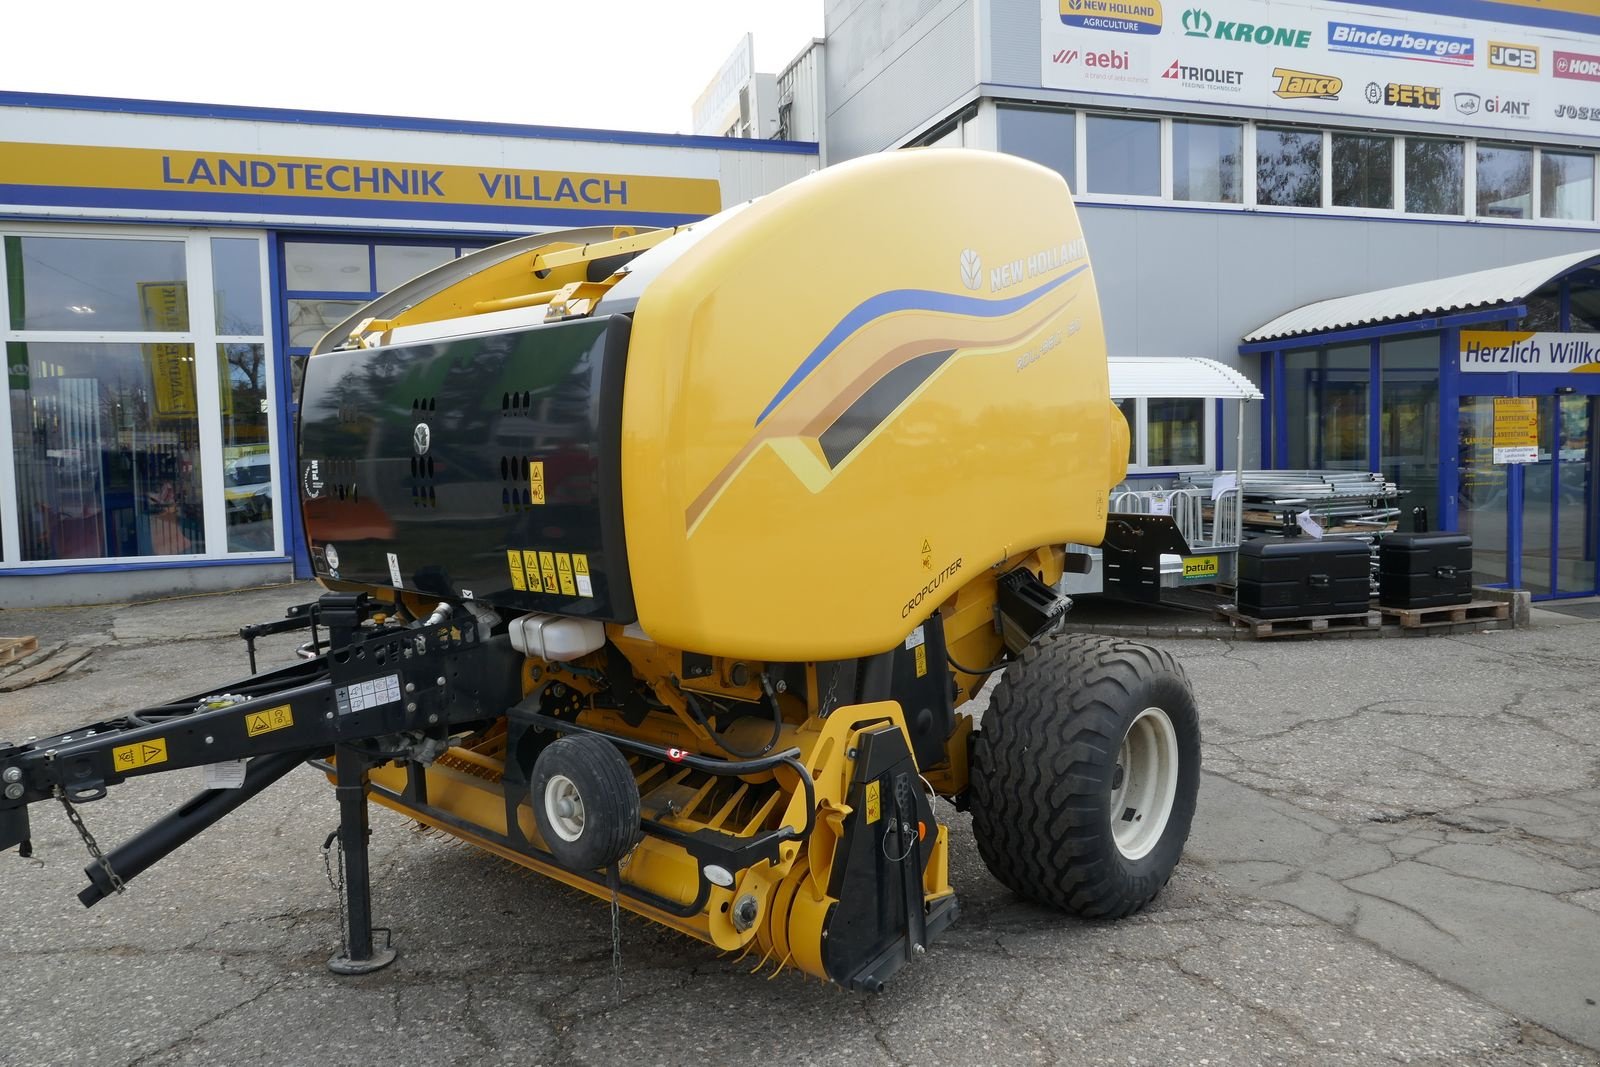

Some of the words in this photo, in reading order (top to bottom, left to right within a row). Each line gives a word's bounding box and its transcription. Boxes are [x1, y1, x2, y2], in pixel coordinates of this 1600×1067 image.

[1084, 1, 1107, 12] NEW
[1109, 4, 1154, 17] HOLLAND
[1083, 17, 1139, 31] AGRICULTURE
[1214, 21, 1312, 49] KRONE
[1332, 26, 1470, 55] Binderberger
[1084, 50, 1129, 70] aebi
[1490, 46, 1536, 69] JCB
[1179, 65, 1244, 85] TRIOLIET
[1272, 67, 1343, 98] Tanco
[162, 156, 445, 196] LANDTECHNIK
[479, 173, 628, 205] VILLACH
[989, 259, 1025, 293] NEW
[1465, 340, 1541, 363] Herzlich
[311, 460, 319, 480] PLM
[1186, 563, 1214, 574] patura
[901, 558, 962, 619] CROPCUTTER
